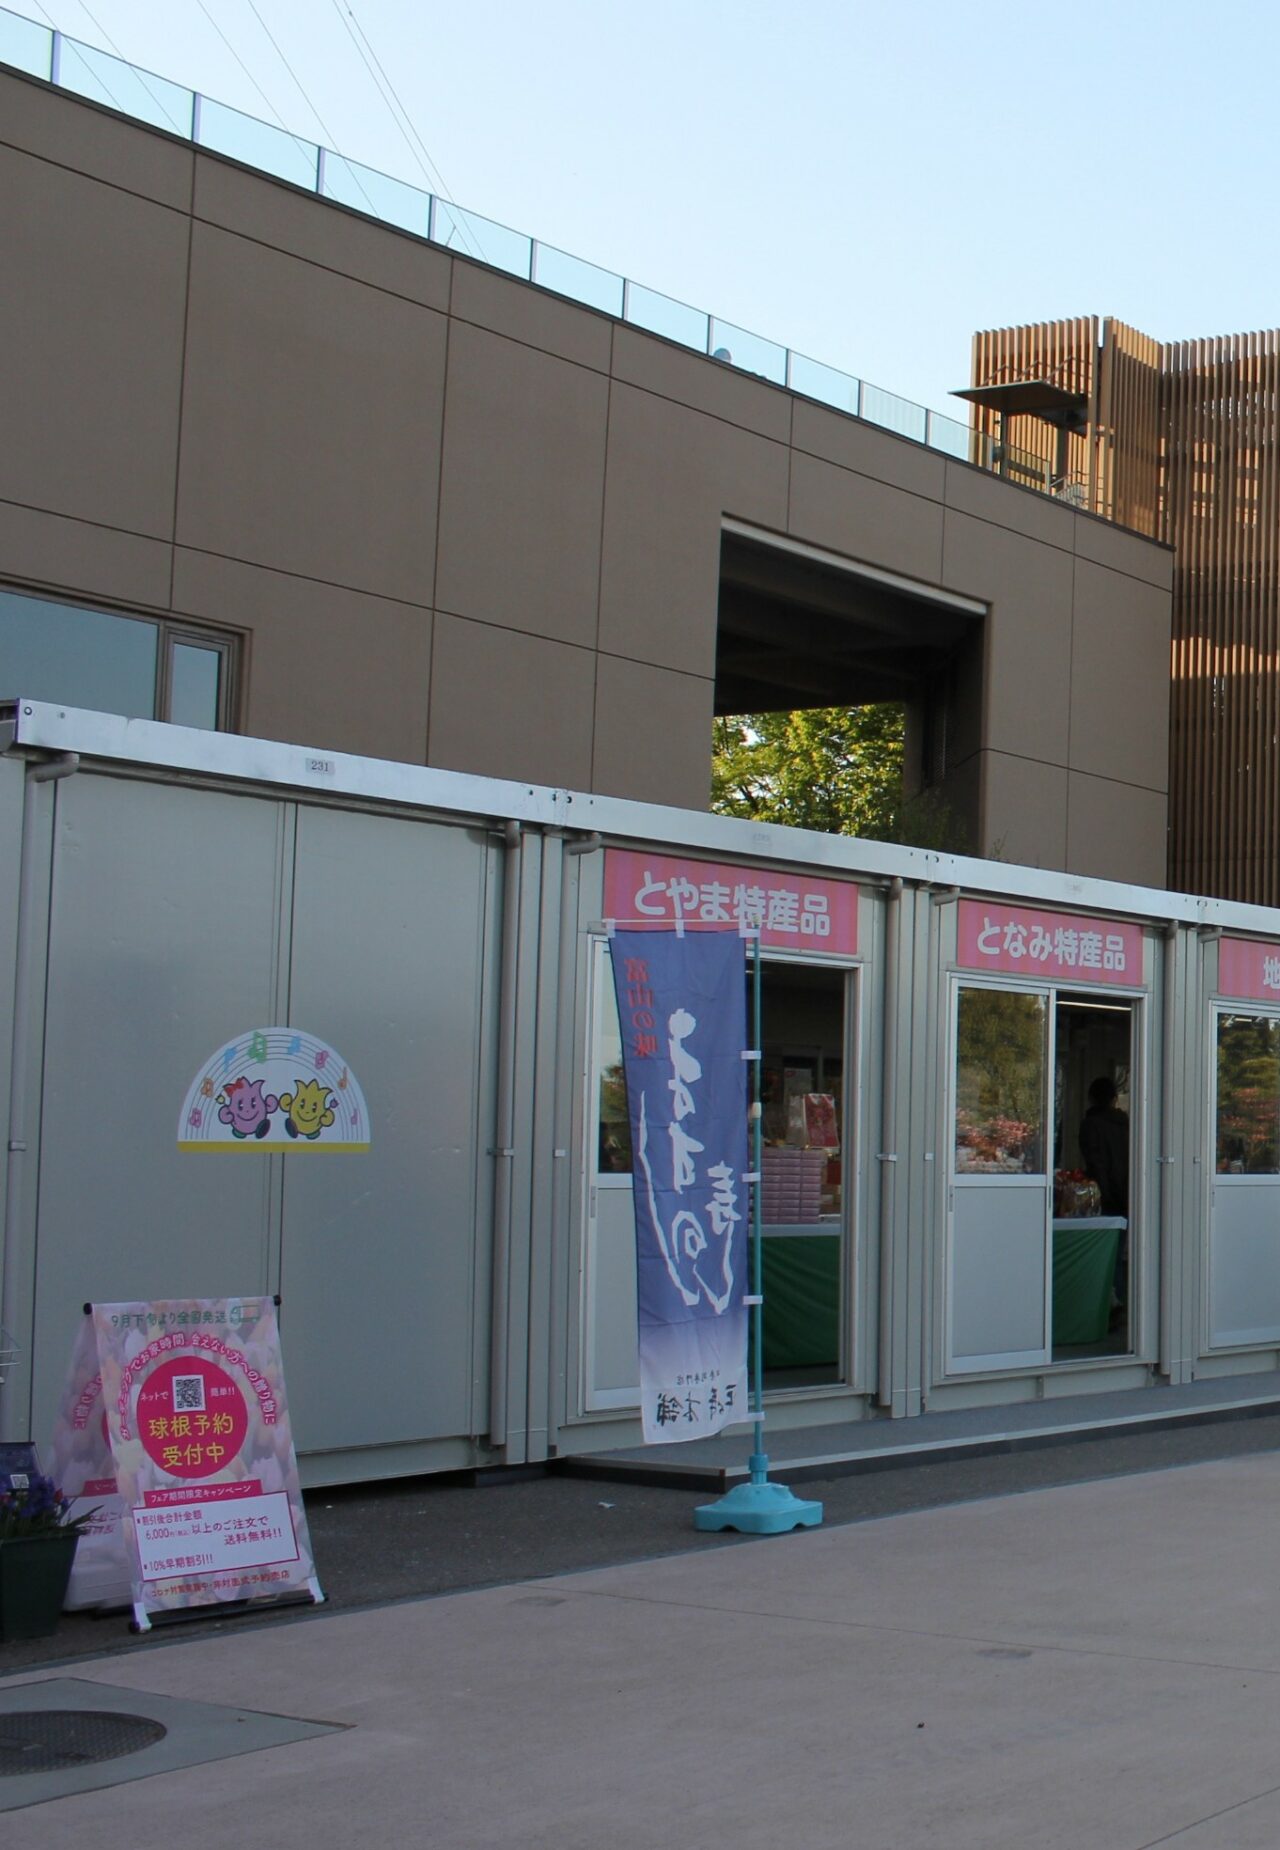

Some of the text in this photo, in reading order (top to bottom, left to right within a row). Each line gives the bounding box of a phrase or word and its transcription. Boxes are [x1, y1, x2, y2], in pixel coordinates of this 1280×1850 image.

[311, 760, 329, 772] 231
[633, 870, 831, 937] とやま特産品
[976, 916, 1126, 972] となみ特産品
[148, 1412, 234, 1440] 球根予約
[162, 1441, 225, 1468] 受付中
[151, 1485, 251, 1503] フェア期間限定キャンペーン
[224, 1527, 282, 1546] 送料無料!!
